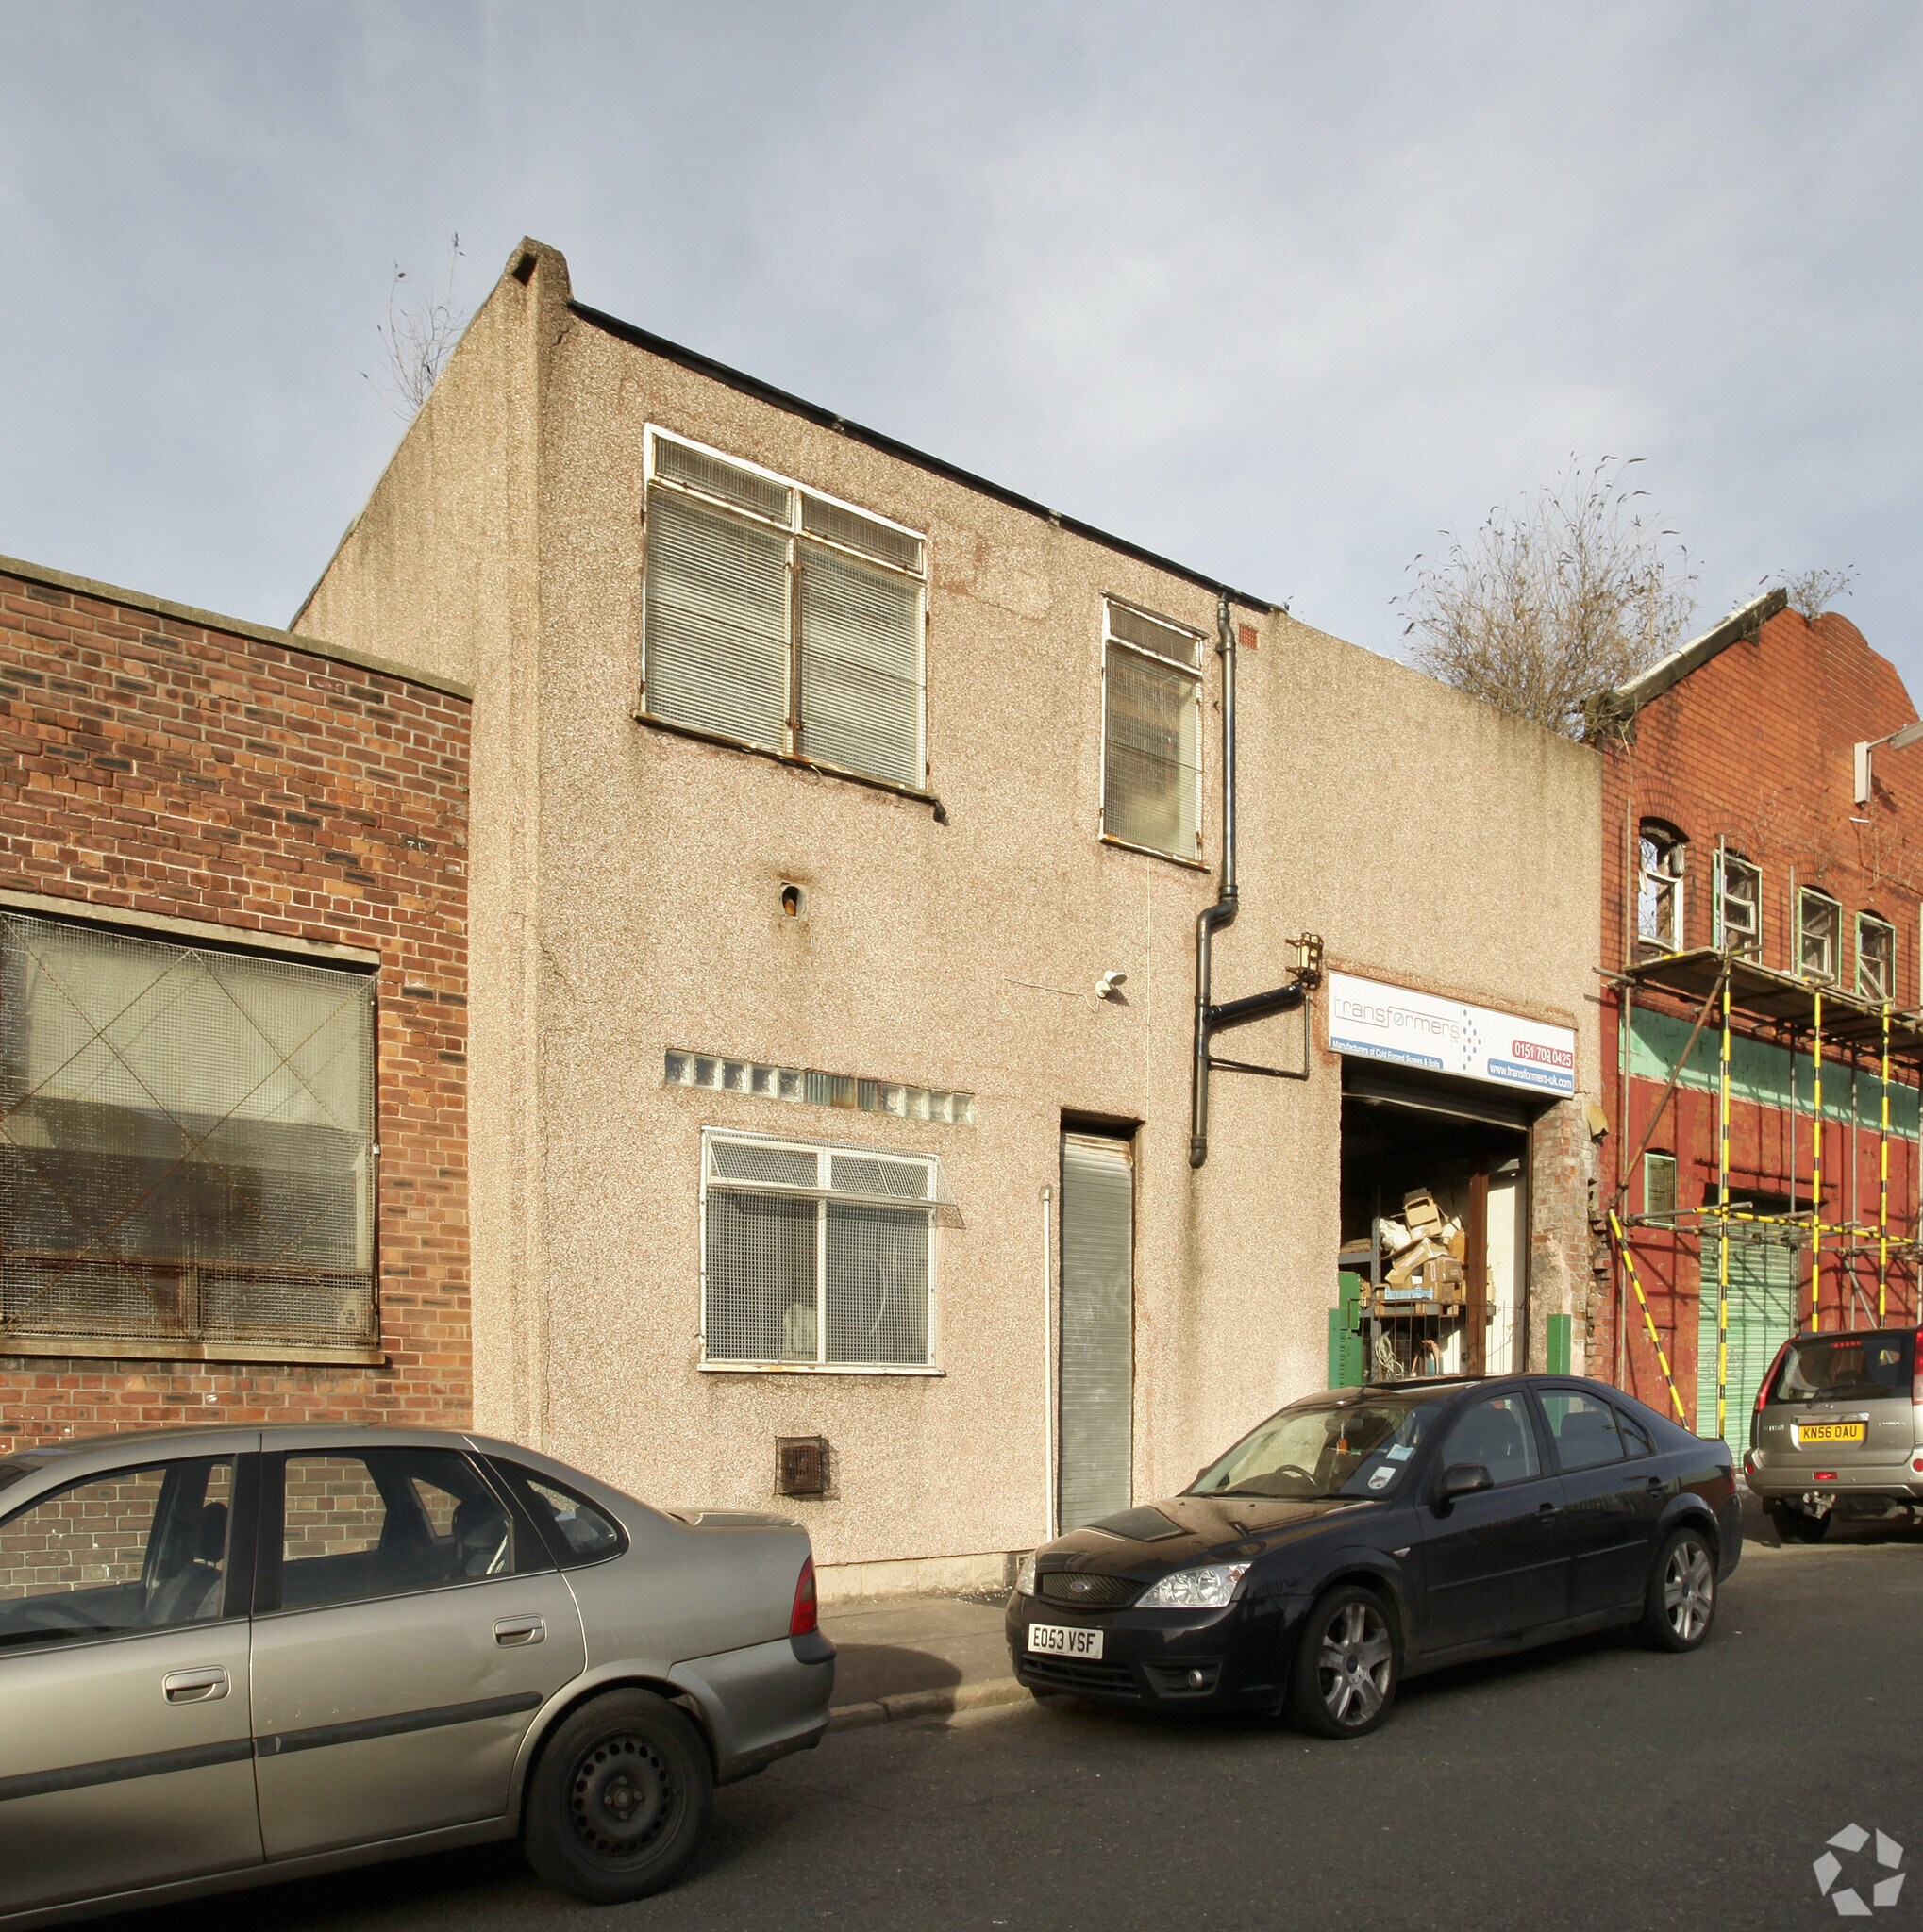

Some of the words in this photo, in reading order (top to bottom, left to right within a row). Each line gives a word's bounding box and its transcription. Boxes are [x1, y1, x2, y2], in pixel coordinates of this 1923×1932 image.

[1332, 1040, 1368, 1054] Manufacturers
[1376, 1049, 1387, 1058] Cold
[1514, 1042, 1533, 1058] 0151
[1536, 1047, 1551, 1063] 709
[1552, 1050, 1572, 1067] 0425
[1490, 1064, 1572, 1088] www.transformers-uk.com
[1803, 1426, 1831, 1439] KN56
[1834, 1425, 1857, 1438] OAU
[1033, 1627, 1064, 1650] EO53
[1069, 1630, 1095, 1653] VSF
